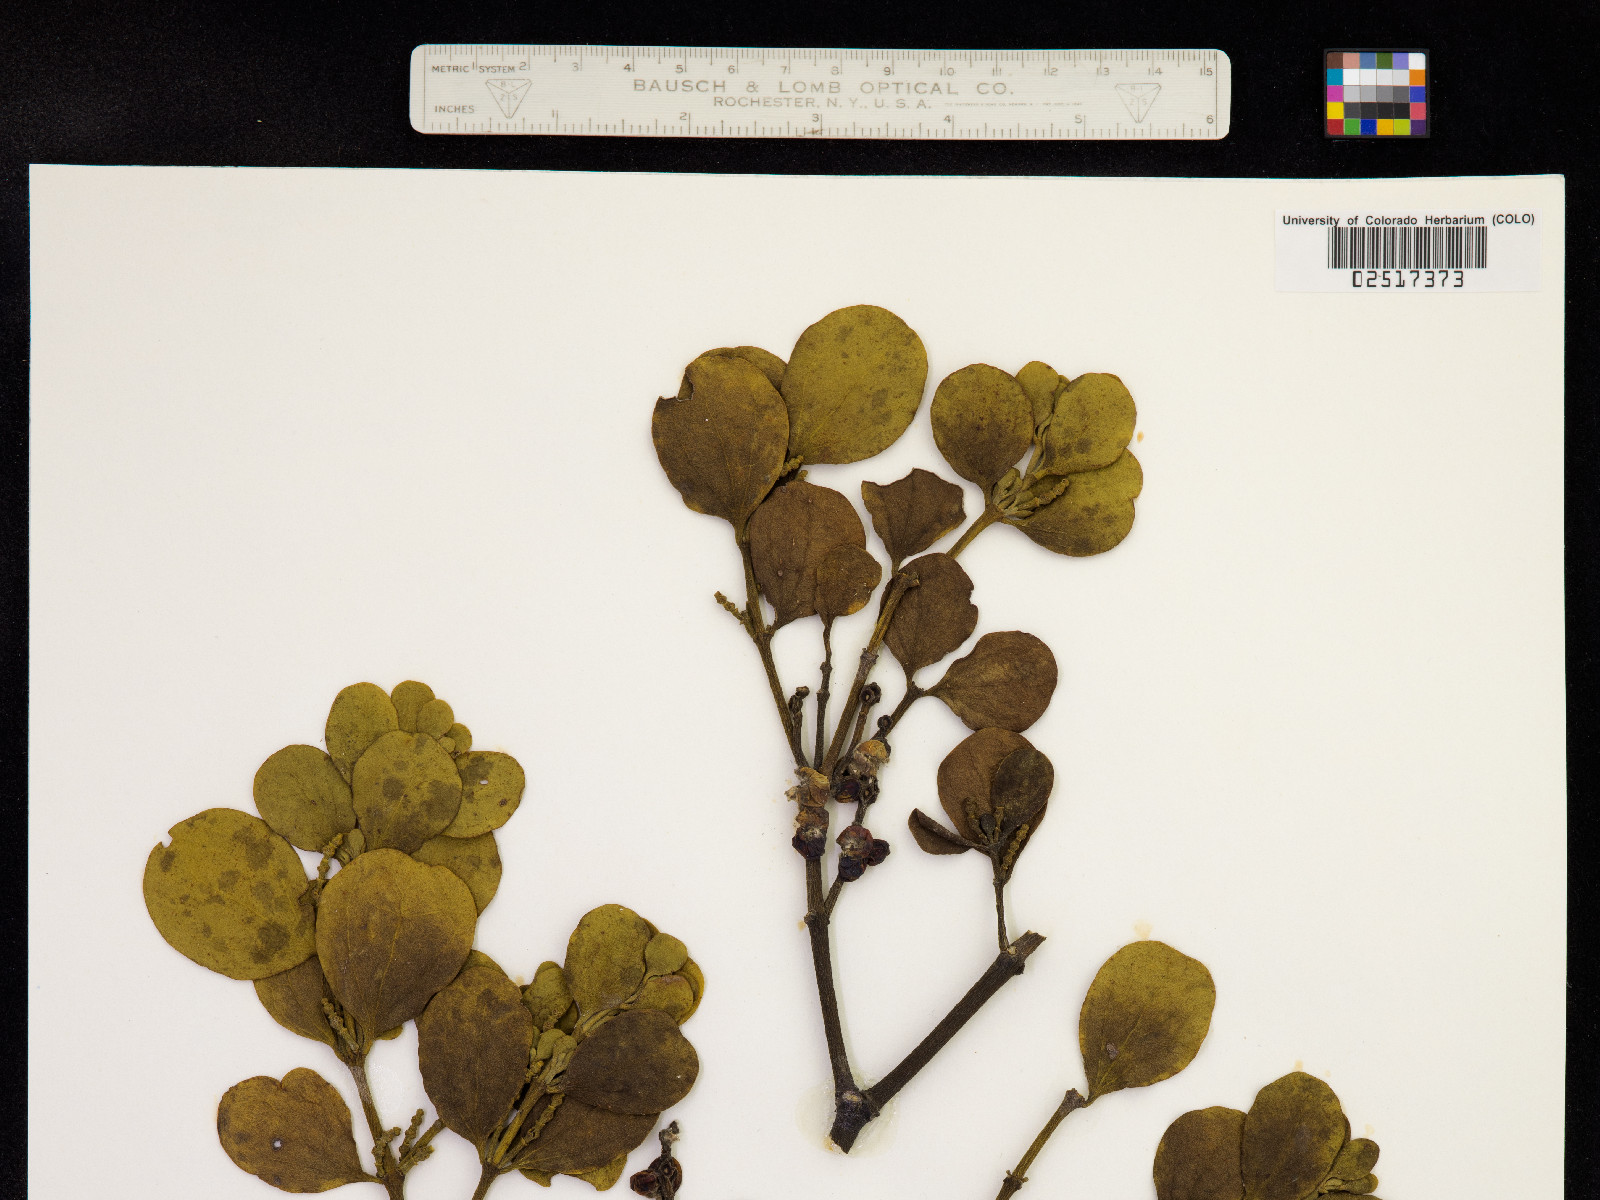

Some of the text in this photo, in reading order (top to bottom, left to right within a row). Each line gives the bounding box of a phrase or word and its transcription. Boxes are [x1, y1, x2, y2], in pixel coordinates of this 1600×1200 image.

[431, 65, 515, 73] METRIC SYSTEM
[519, 61, 528, 71] 2
[571, 62, 580, 72] 3
[623, 63, 632, 72] 4
[675, 64, 684, 74] 5
[727, 65, 736, 74] 6
[780, 65, 788, 75] 7
[831, 66, 840, 75] 8
[883, 66, 892, 76] 9
[1200, 67, 1213, 76] 15
[633, 79, 1014, 95] BAUSCH & LOMB OPTICAL CO.
[434, 105, 475, 113] INCHES
[679, 111, 688, 121] 2
[812, 113, 820, 122] 3
[943, 114, 952, 123] 4
[1206, 115, 1214, 124] 6
[1282, 213, 1535, 227] University of Colorado Herbarium (COLO)
[1352, 270, 1464, 288] 02517373
